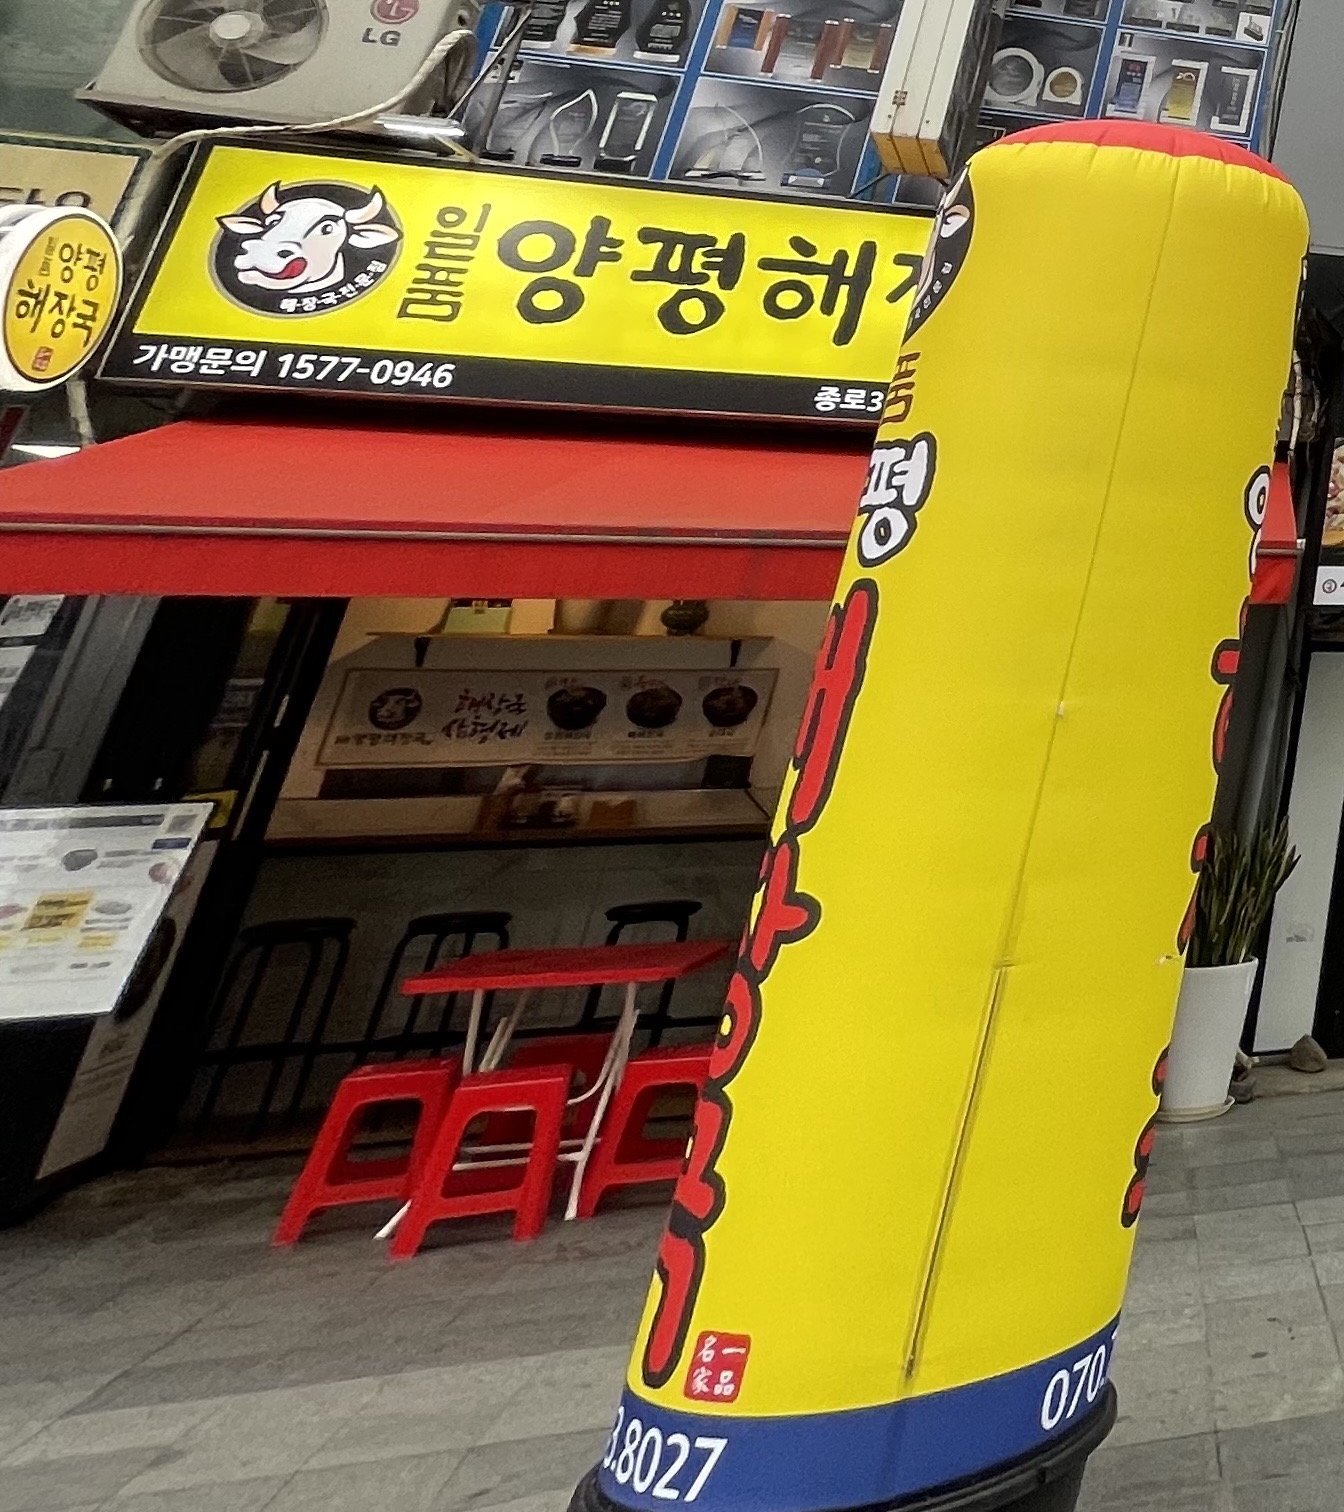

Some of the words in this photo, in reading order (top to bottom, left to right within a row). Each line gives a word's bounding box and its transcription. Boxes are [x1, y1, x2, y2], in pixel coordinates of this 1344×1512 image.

[362, 28, 401, 47] LG
[59, 243, 107, 291] 양평
[396, 203, 491, 322] 일품
[16, 279, 99, 348] 해장국
[133, 343, 268, 379] 가맹문의
[277, 352, 456, 388] 1577-0946
